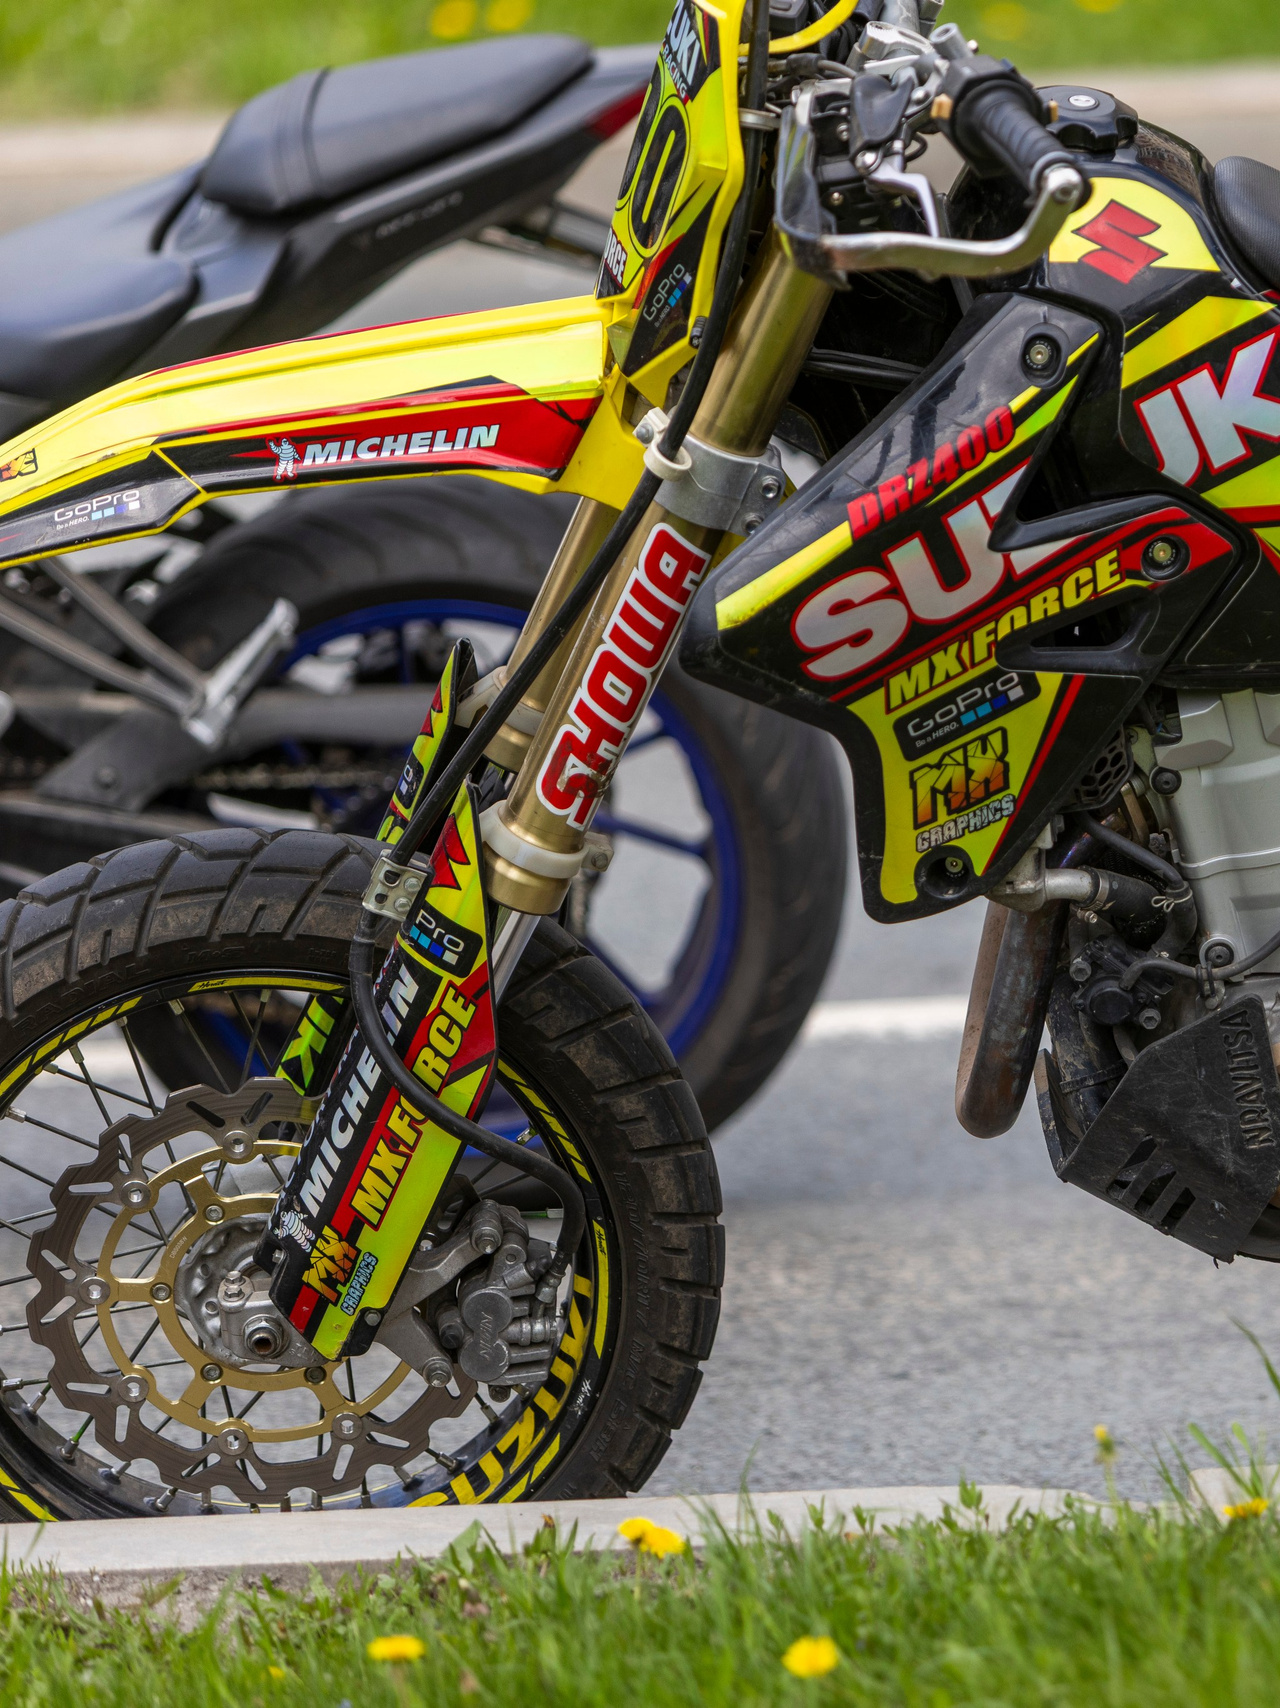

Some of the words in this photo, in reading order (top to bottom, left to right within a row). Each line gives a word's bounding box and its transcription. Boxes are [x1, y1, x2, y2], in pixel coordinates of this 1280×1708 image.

[663, 44, 688, 98] RACING
[665, 0, 701, 86] UKI
[643, 263, 686, 321] GoPro
[303, 424, 500, 466] MICHELIN
[847, 404, 1016, 541] DRZ400
[54, 489, 140, 522] GoPro
[536, 523, 712, 832] SHOWA
[889, 641, 964, 711] MX
[907, 672, 1020, 737] GoPro
[915, 738, 927, 749] Be
[926, 735, 933, 744] a
[932, 721, 960, 740] HERO.
[909, 726, 1011, 831] MX
[915, 794, 1017, 853] GRAPHICS
[299, 963, 419, 1218] MICHEIN
[1219, 1009, 1277, 1149] NRAVITSA
[350, 1139, 407, 1226] MX
[302, 1225, 363, 1308] MX
[340, 1251, 380, 1317] GRAPHICS
[407, 1274, 593, 1507] UZUKI
